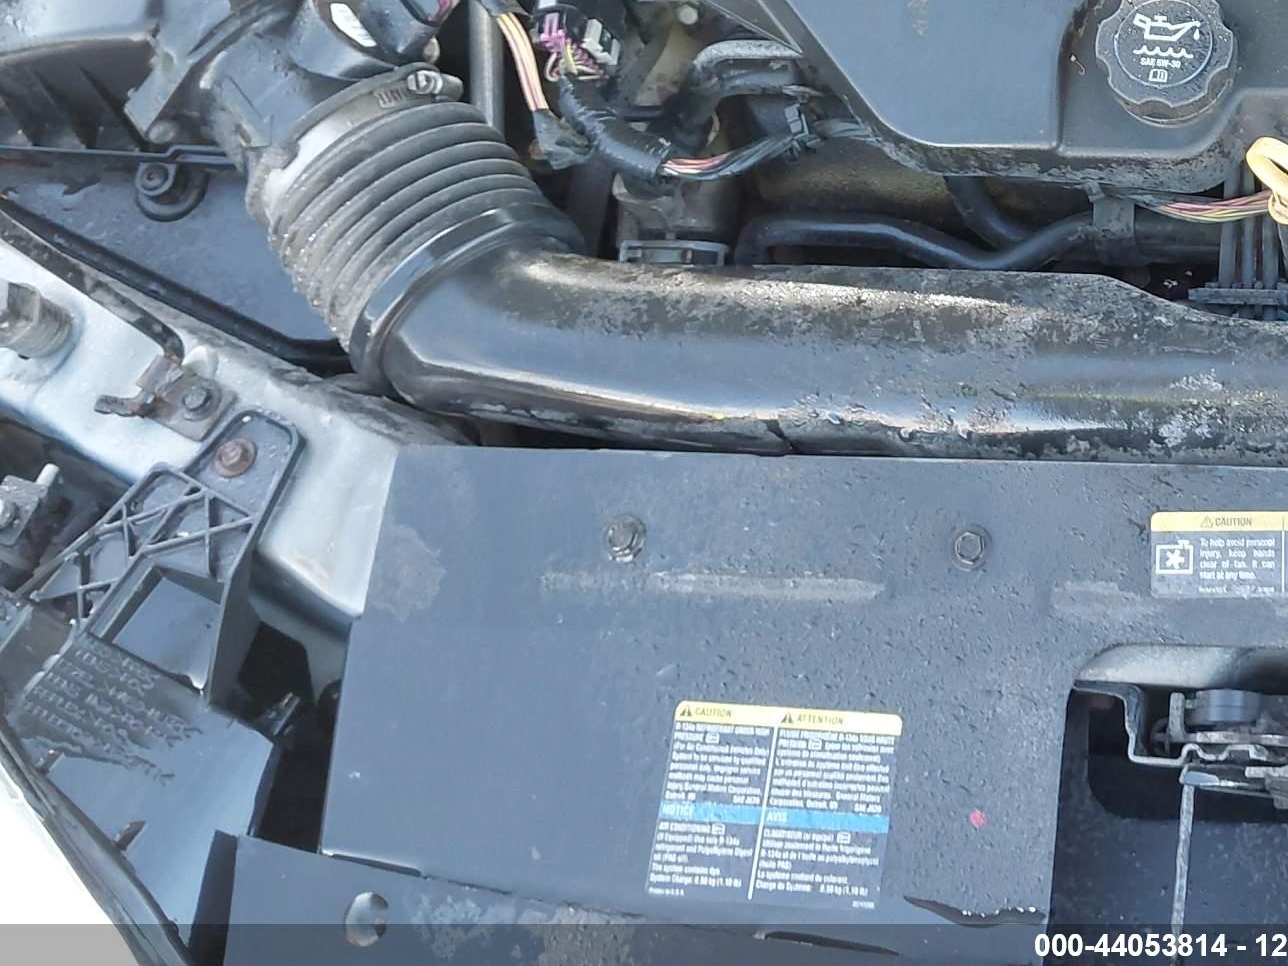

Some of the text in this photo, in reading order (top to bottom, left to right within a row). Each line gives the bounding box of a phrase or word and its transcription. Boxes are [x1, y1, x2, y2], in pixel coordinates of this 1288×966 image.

[1140, 57, 1155, 66] SAE
[1214, 517, 1252, 527] CAUTION
[1200, 538, 1276, 548] To help avoid personal
[694, 707, 732, 717] CAUTION
[796, 714, 844, 725] ATTENTION
[662, 802, 695, 815] NOTICE
[767, 811, 788, 822] AVIS
